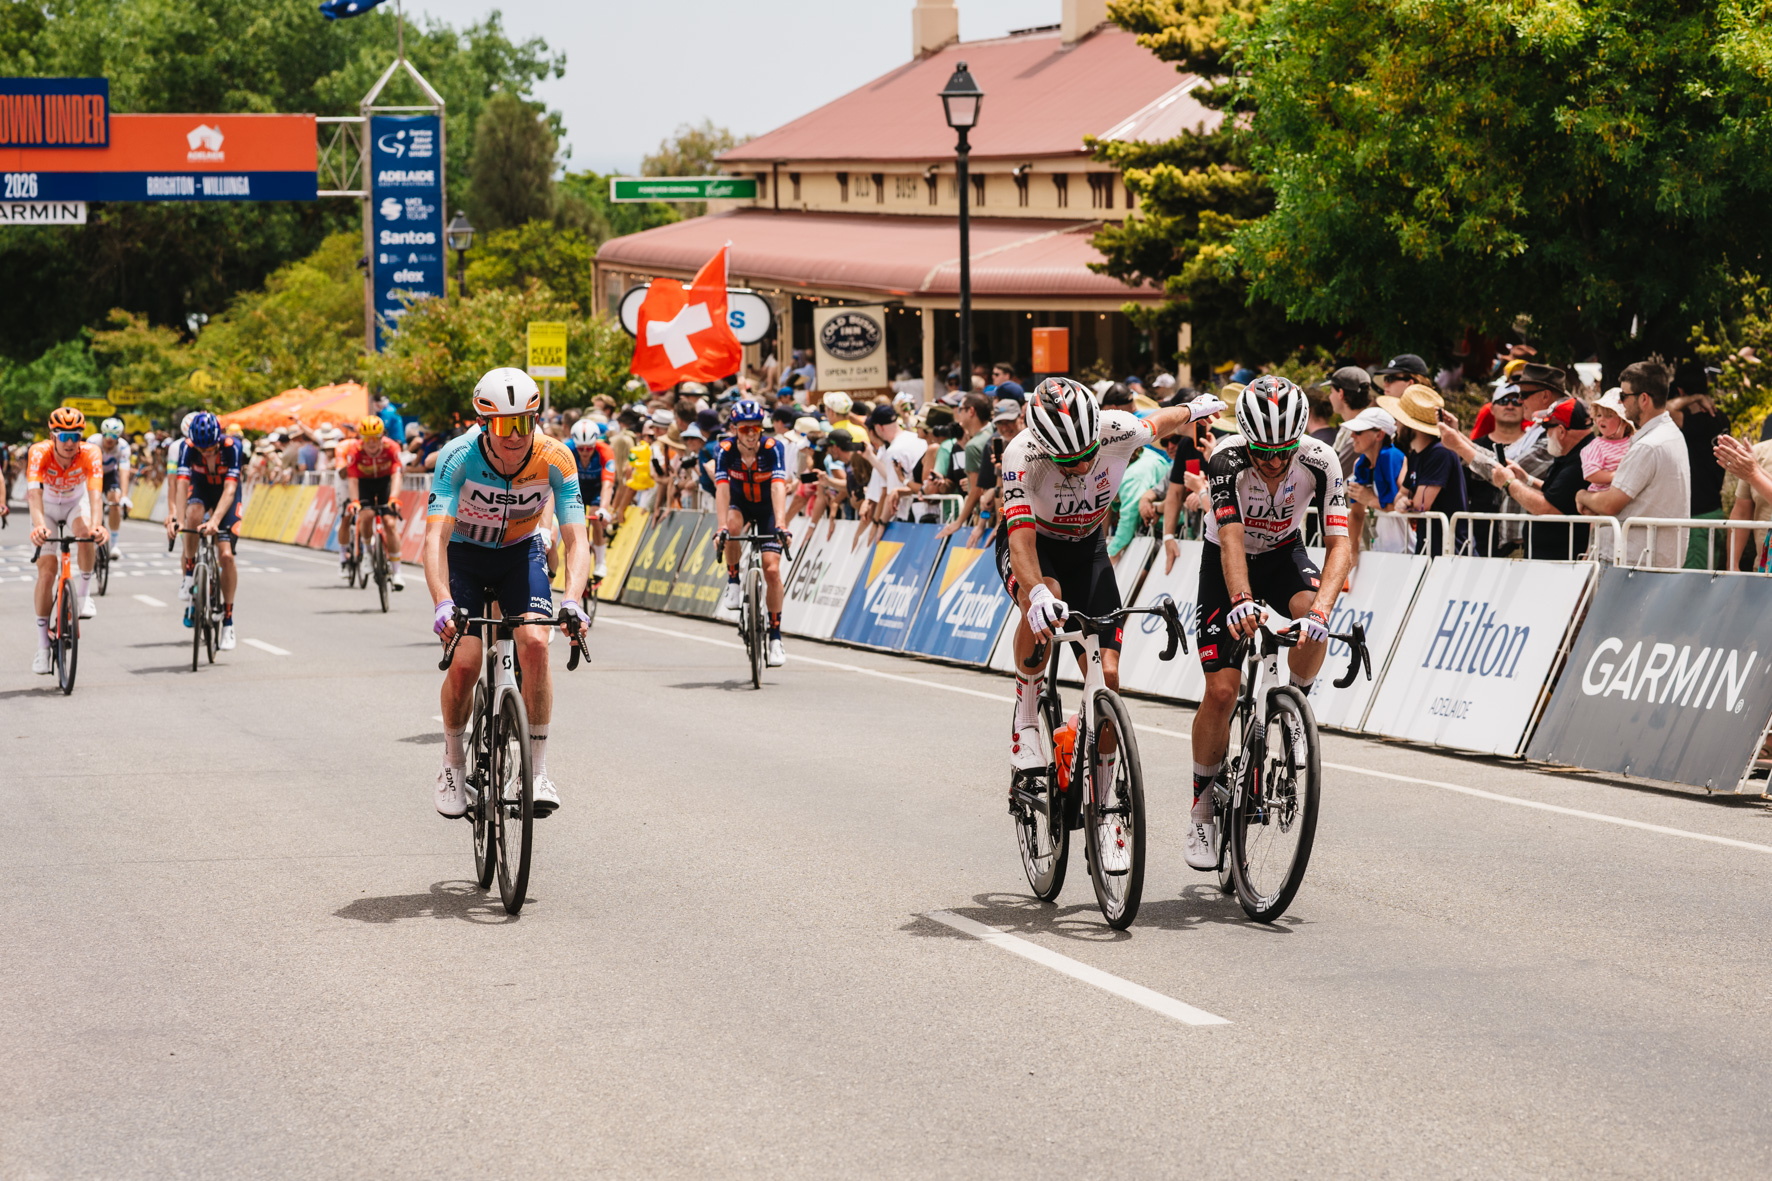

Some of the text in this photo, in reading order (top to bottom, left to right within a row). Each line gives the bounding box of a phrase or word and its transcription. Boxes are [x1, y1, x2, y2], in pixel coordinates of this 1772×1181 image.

[44, 94, 106, 144] UNDER
[378, 170, 434, 182] ADELAIDE
[4, 173, 38, 198] 2026
[147, 176, 195, 196] BRIGHTON
[202, 176, 251, 196] WILLUNGA
[405, 205, 435, 213] WORLD
[379, 229, 436, 245] Santos
[393, 268, 424, 283] efex
[824, 315, 877, 337] OLD BUSH
[839, 326, 862, 336] INN
[531, 346, 563, 355] KEEP
[531, 356, 563, 366] CLEAR
[824, 366, 879, 376] OPEN 7 DAYS
[1305, 456, 1329, 470] Analog
[42, 474, 87, 486] INEOS
[1054, 490, 1111, 516] UAE
[1246, 505, 1295, 520] UAE
[791, 549, 832, 604] efex
[869, 573, 919, 626] Ziptrak
[945, 581, 1006, 638] Ziptrak
[1421, 599, 1530, 679] Hilton
[1581, 636, 1758, 713] GARMIN
[1429, 696, 1473, 720] ADELAIDE
